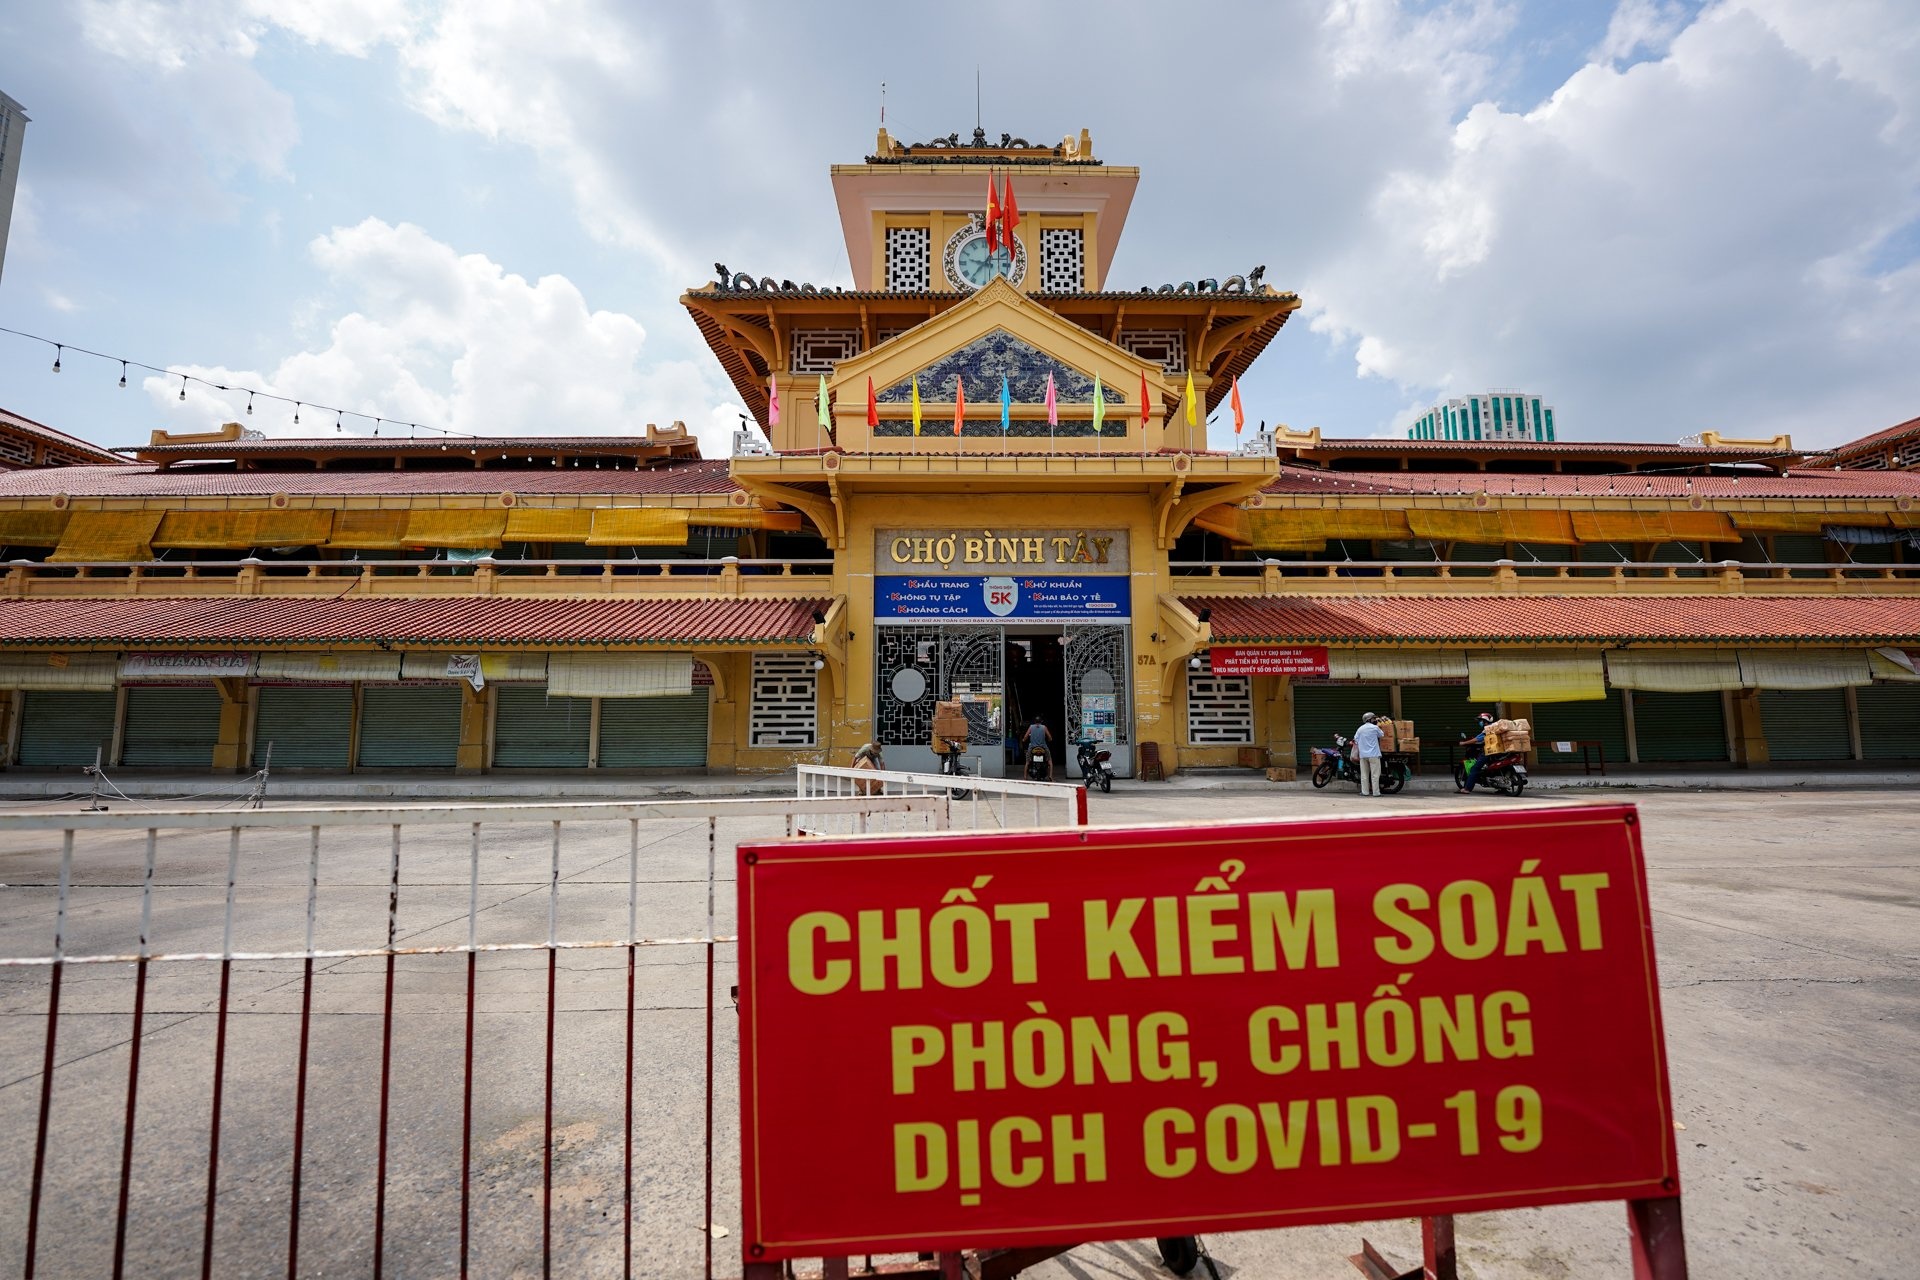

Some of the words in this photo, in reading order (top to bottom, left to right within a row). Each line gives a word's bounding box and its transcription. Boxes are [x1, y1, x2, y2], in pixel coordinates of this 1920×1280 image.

[891, 533, 957, 570] CHỢ
[963, 530, 1046, 564] BÌNH
[1051, 531, 1114, 564] TÂY
[891, 592, 926, 601] KHÔNG
[944, 593, 961, 602] TẬP
[990, 591, 1012, 605] 5K
[1033, 592, 1058, 601] KHAI
[942, 605, 968, 613] CÁCH
[1138, 654, 1157, 666] 57A
[787, 875, 1050, 995] CHỐT
[1083, 859, 1340, 981] KIỂM
[1373, 859, 1610, 964] SOÁT
[891, 1001, 1218, 1094] PHÒNG,
[1248, 973, 1534, 1075] CHỐNG
[894, 1113, 1107, 1206] DỊCH
[1143, 1084, 1544, 1178] COVID-19
